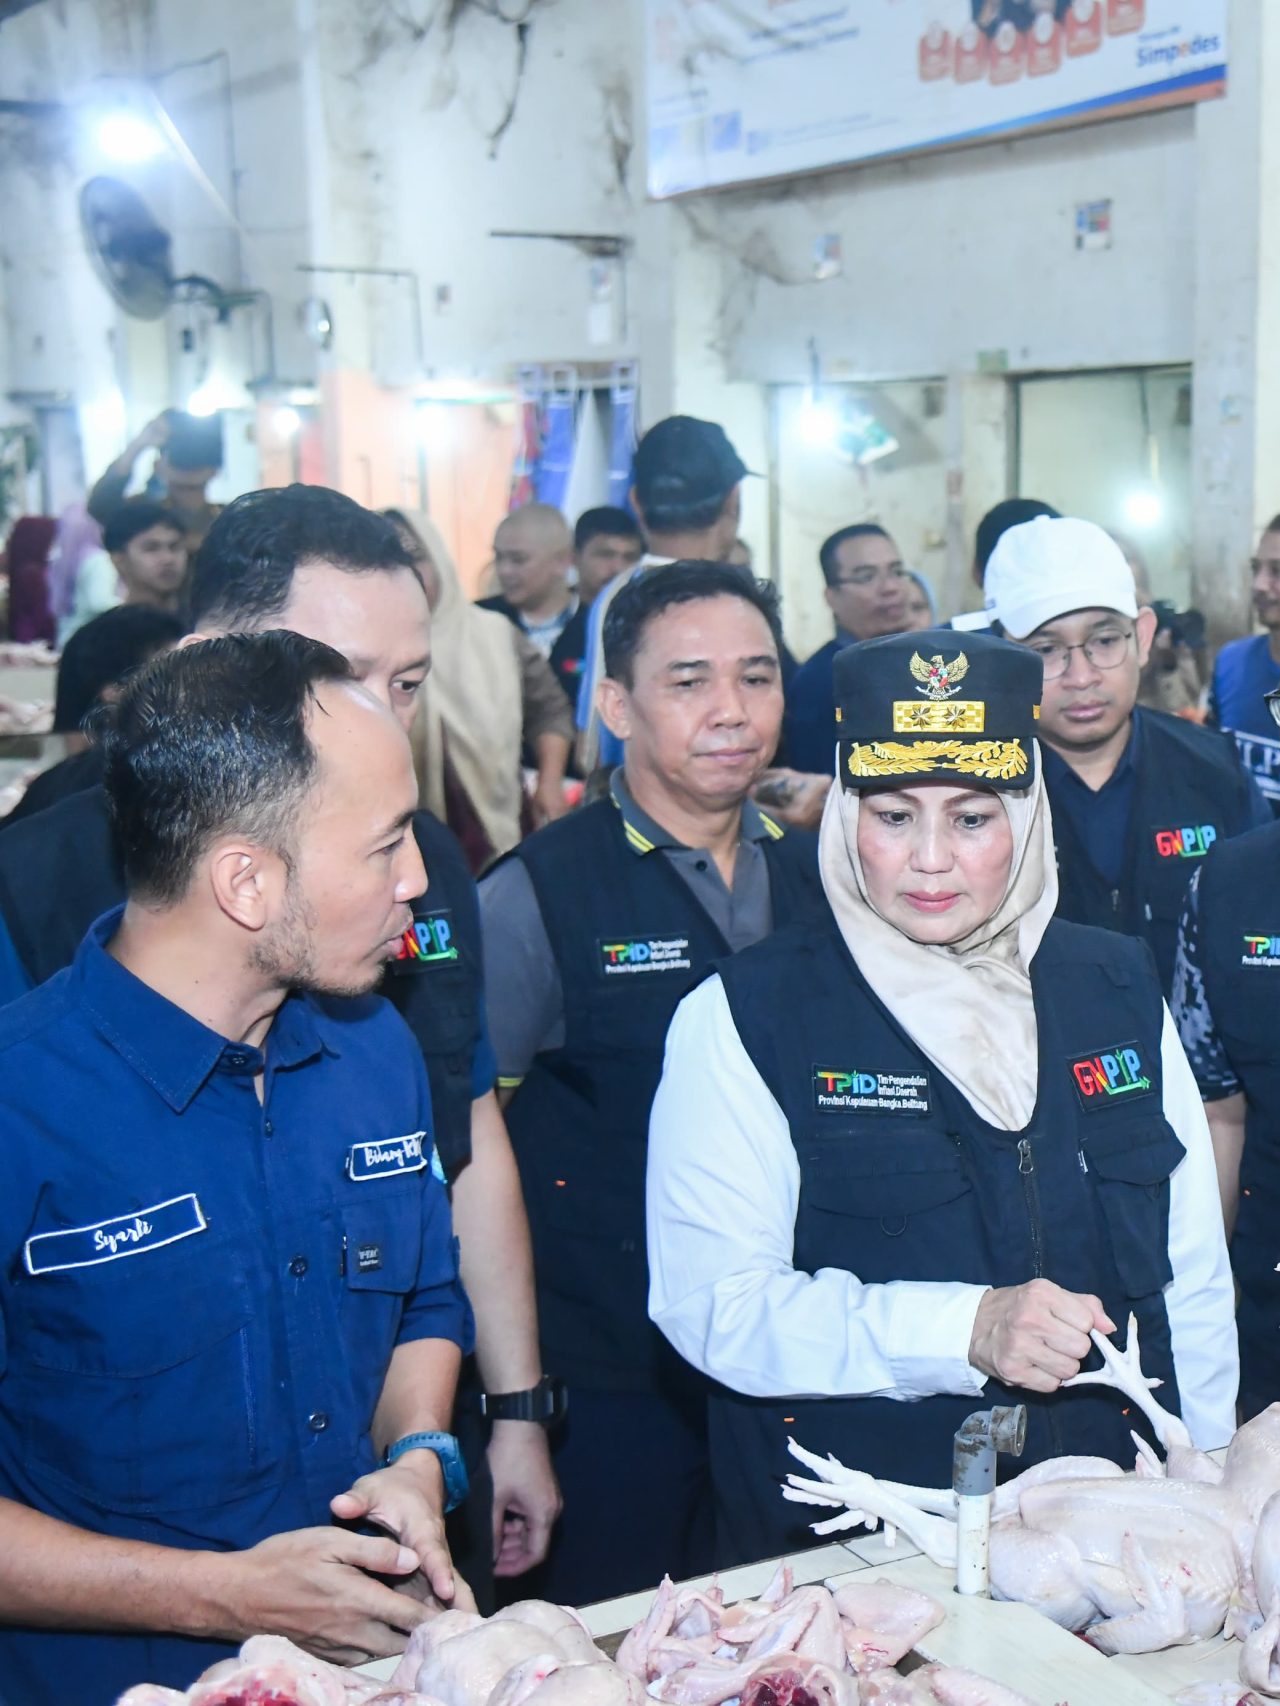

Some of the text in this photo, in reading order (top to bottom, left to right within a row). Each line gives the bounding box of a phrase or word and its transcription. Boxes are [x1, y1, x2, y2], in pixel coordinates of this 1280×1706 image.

[1137, 36, 1220, 67] Simpedes
[1155, 825, 1217, 857] GNPIP
[603, 943, 651, 963] TPID
[817, 1070, 877, 1094] TPID
[1073, 1048, 1143, 1095] GNPIP
